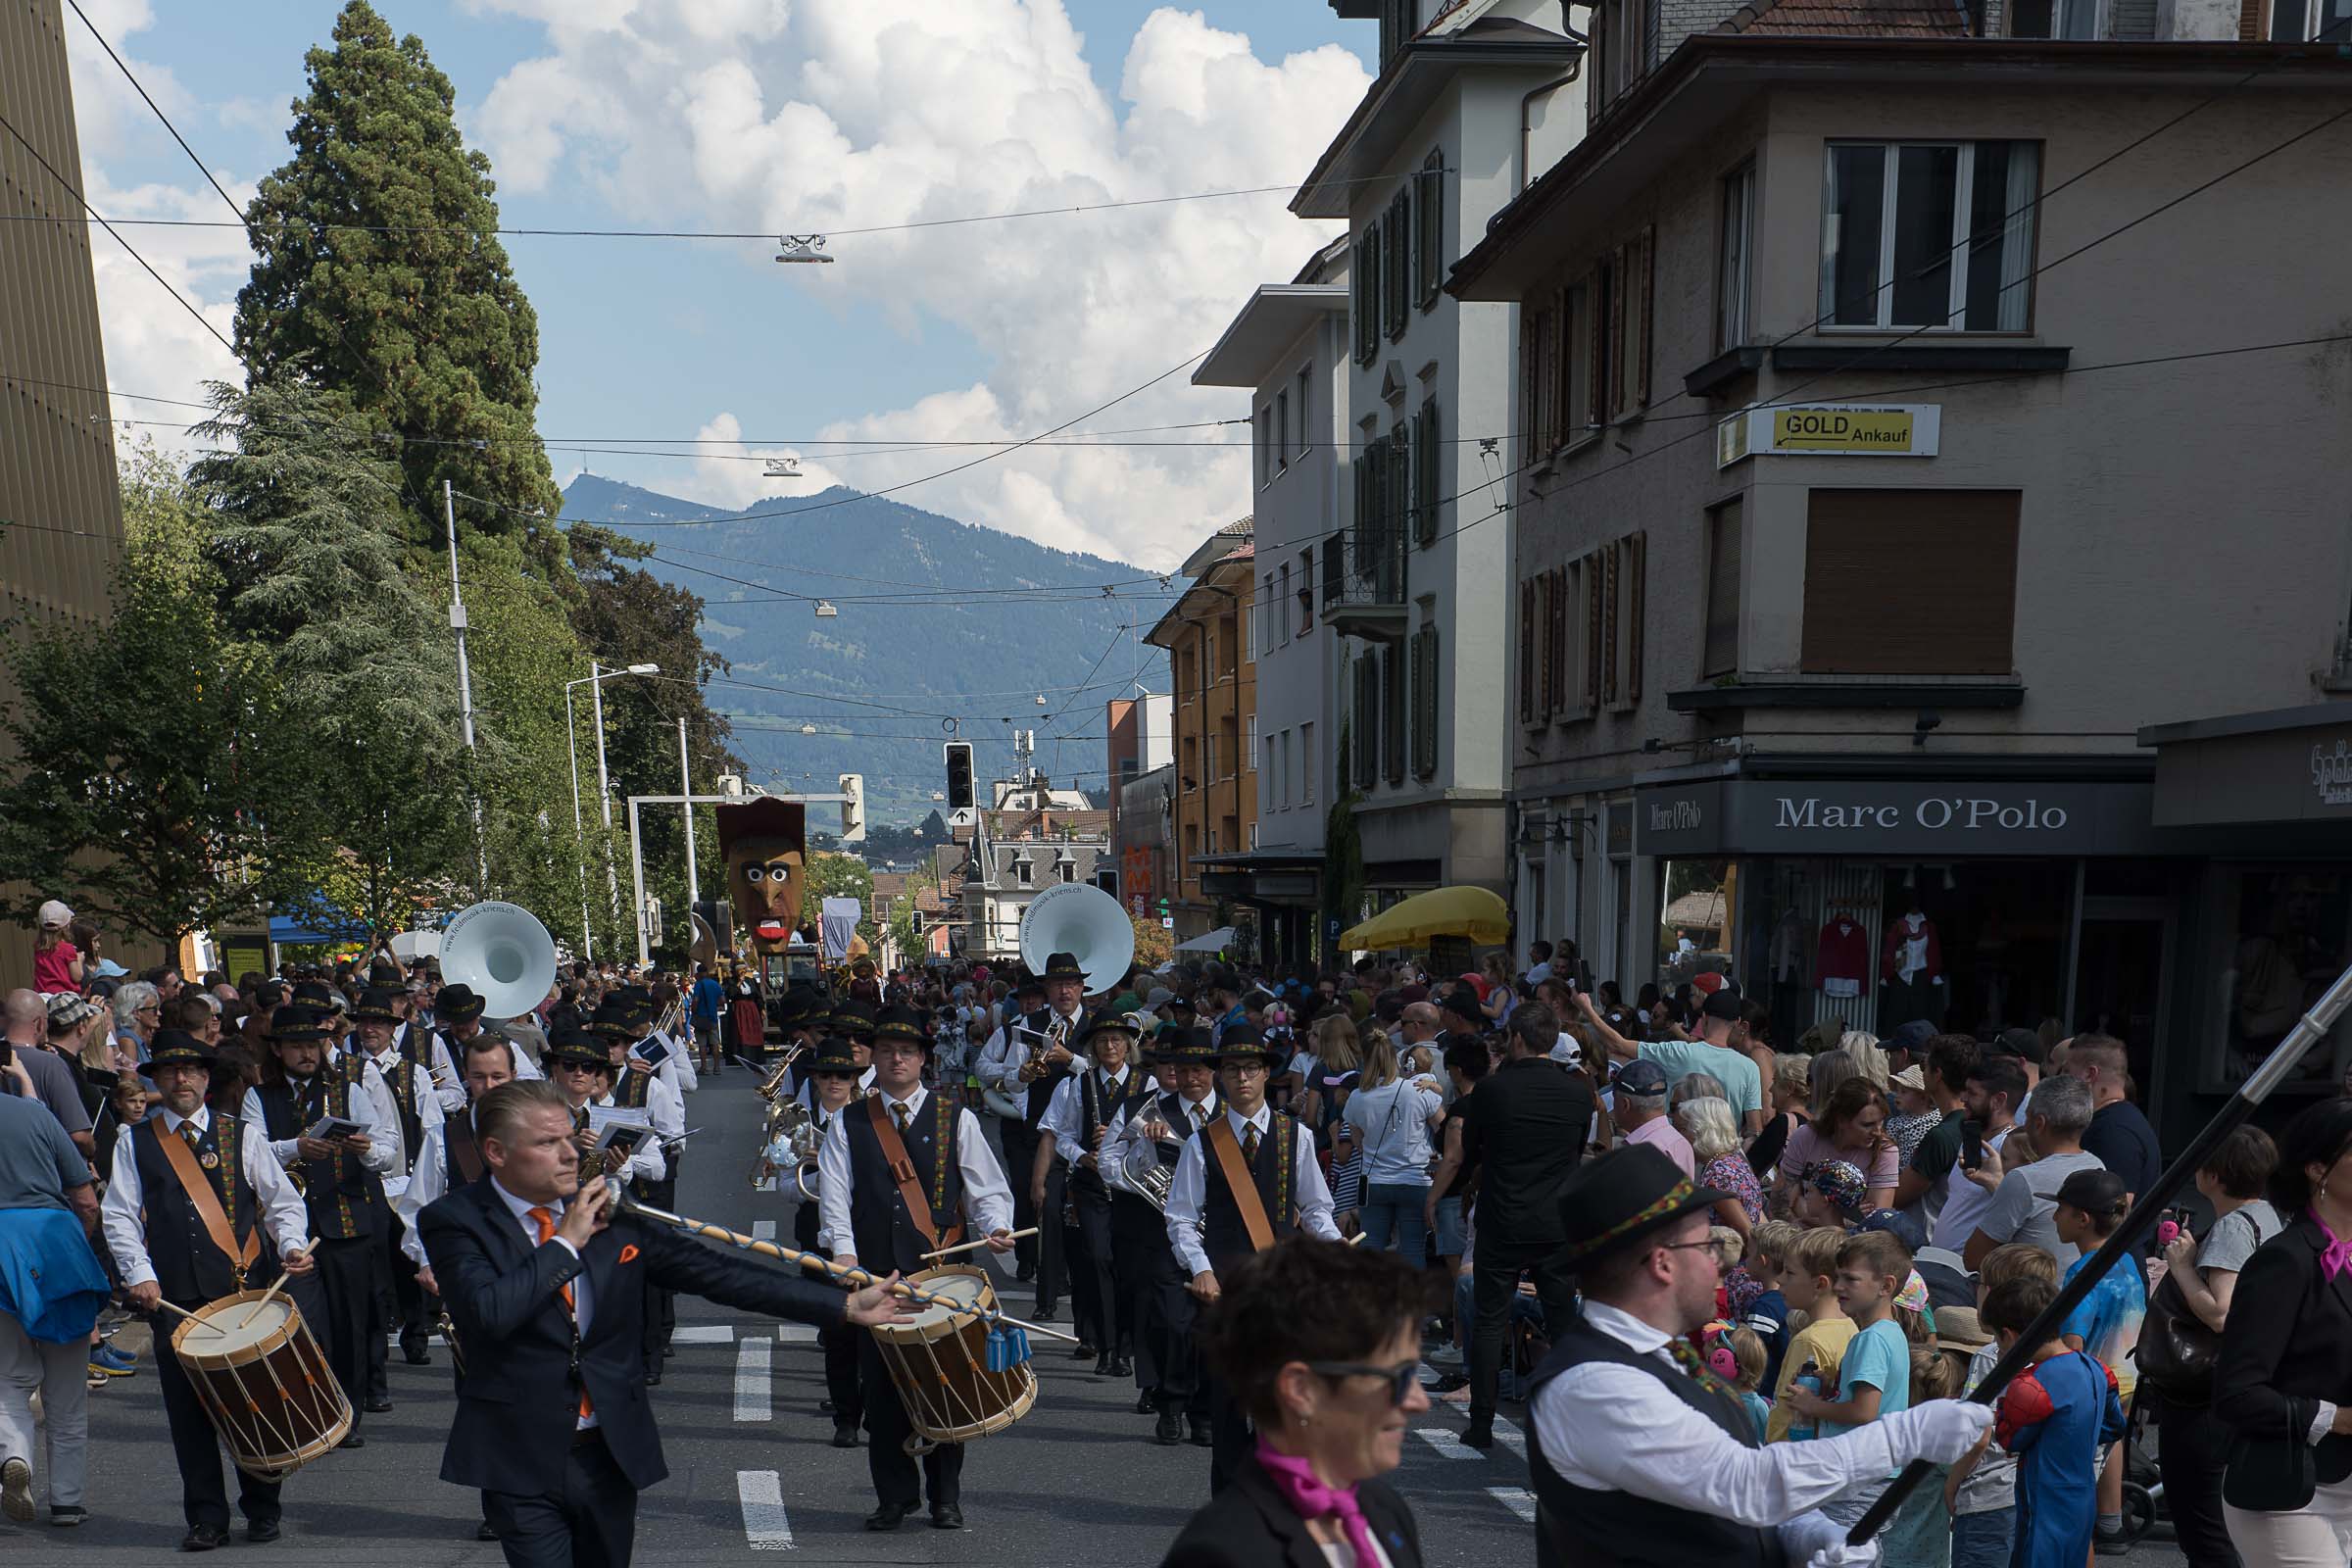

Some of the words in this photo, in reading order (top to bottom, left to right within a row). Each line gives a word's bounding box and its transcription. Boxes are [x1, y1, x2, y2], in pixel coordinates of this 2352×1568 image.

[1787, 415, 1848, 434] GOLD
[1852, 425, 1907, 443] Ankauf
[1651, 804, 1673, 831] Marc
[1673, 801, 1701, 830] O'Polo
[1776, 798, 1899, 828] Marc
[1916, 798, 2068, 830] O'Polo
[444, 906, 515, 953] www.feldmusik-kriens.ch
[1024, 887, 1082, 943] www.feldmusik-kriens.ch
